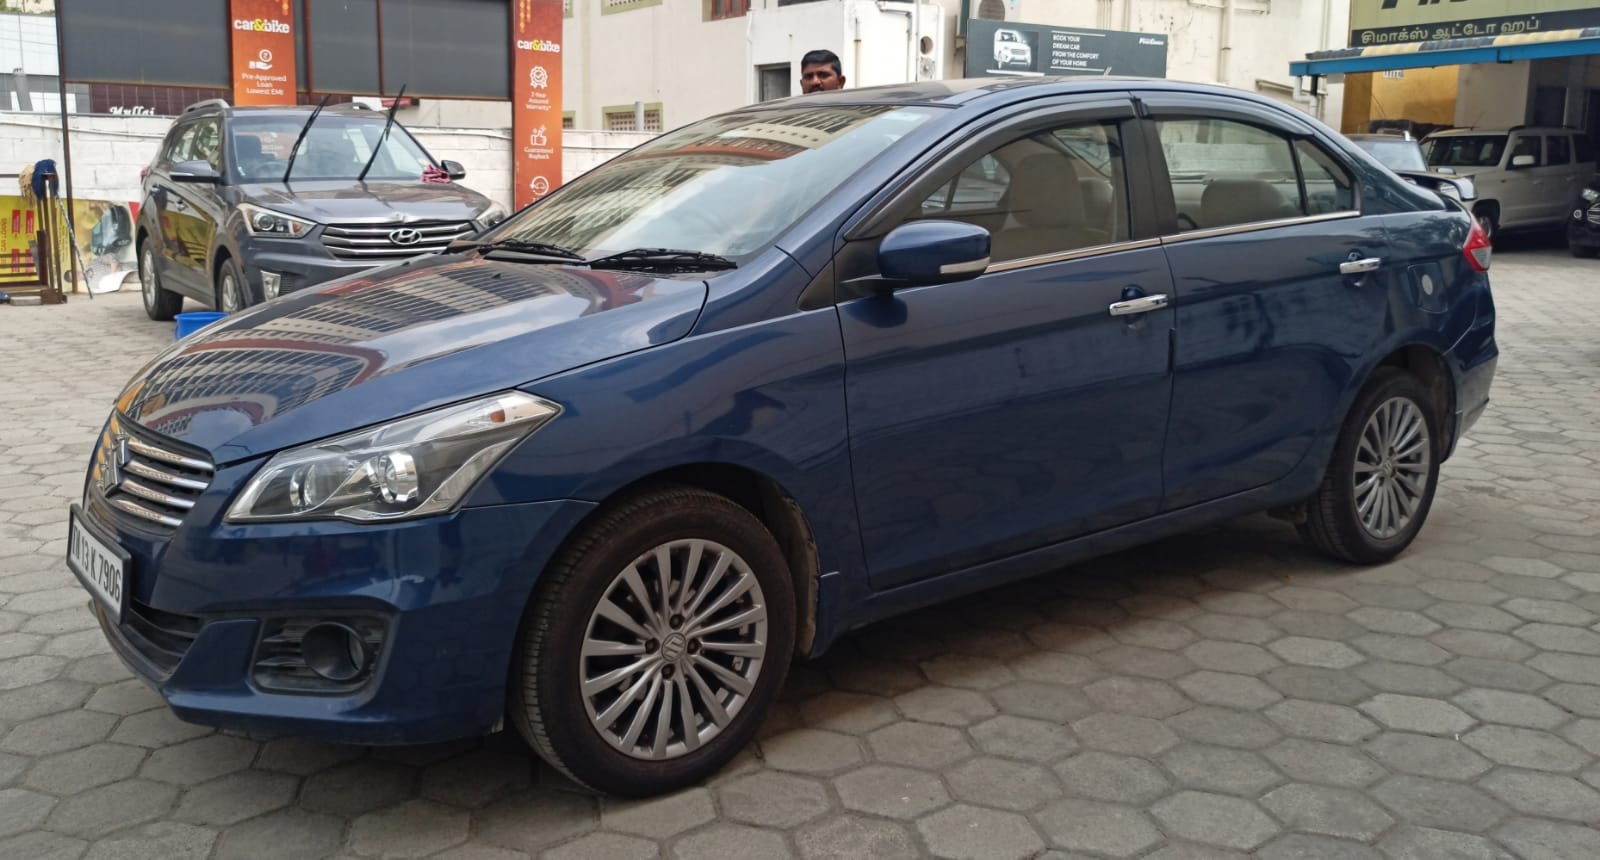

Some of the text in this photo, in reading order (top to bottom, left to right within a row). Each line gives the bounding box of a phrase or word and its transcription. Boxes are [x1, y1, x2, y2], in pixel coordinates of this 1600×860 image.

[234, 18, 290, 33] car&bike
[1432, 22, 1497, 40] ஆட்டோ
[1501, 16, 1539, 34] ஹப்
[517, 39, 560, 53] car&bike
[72, 524, 121, 602] TN 13 K 7906
